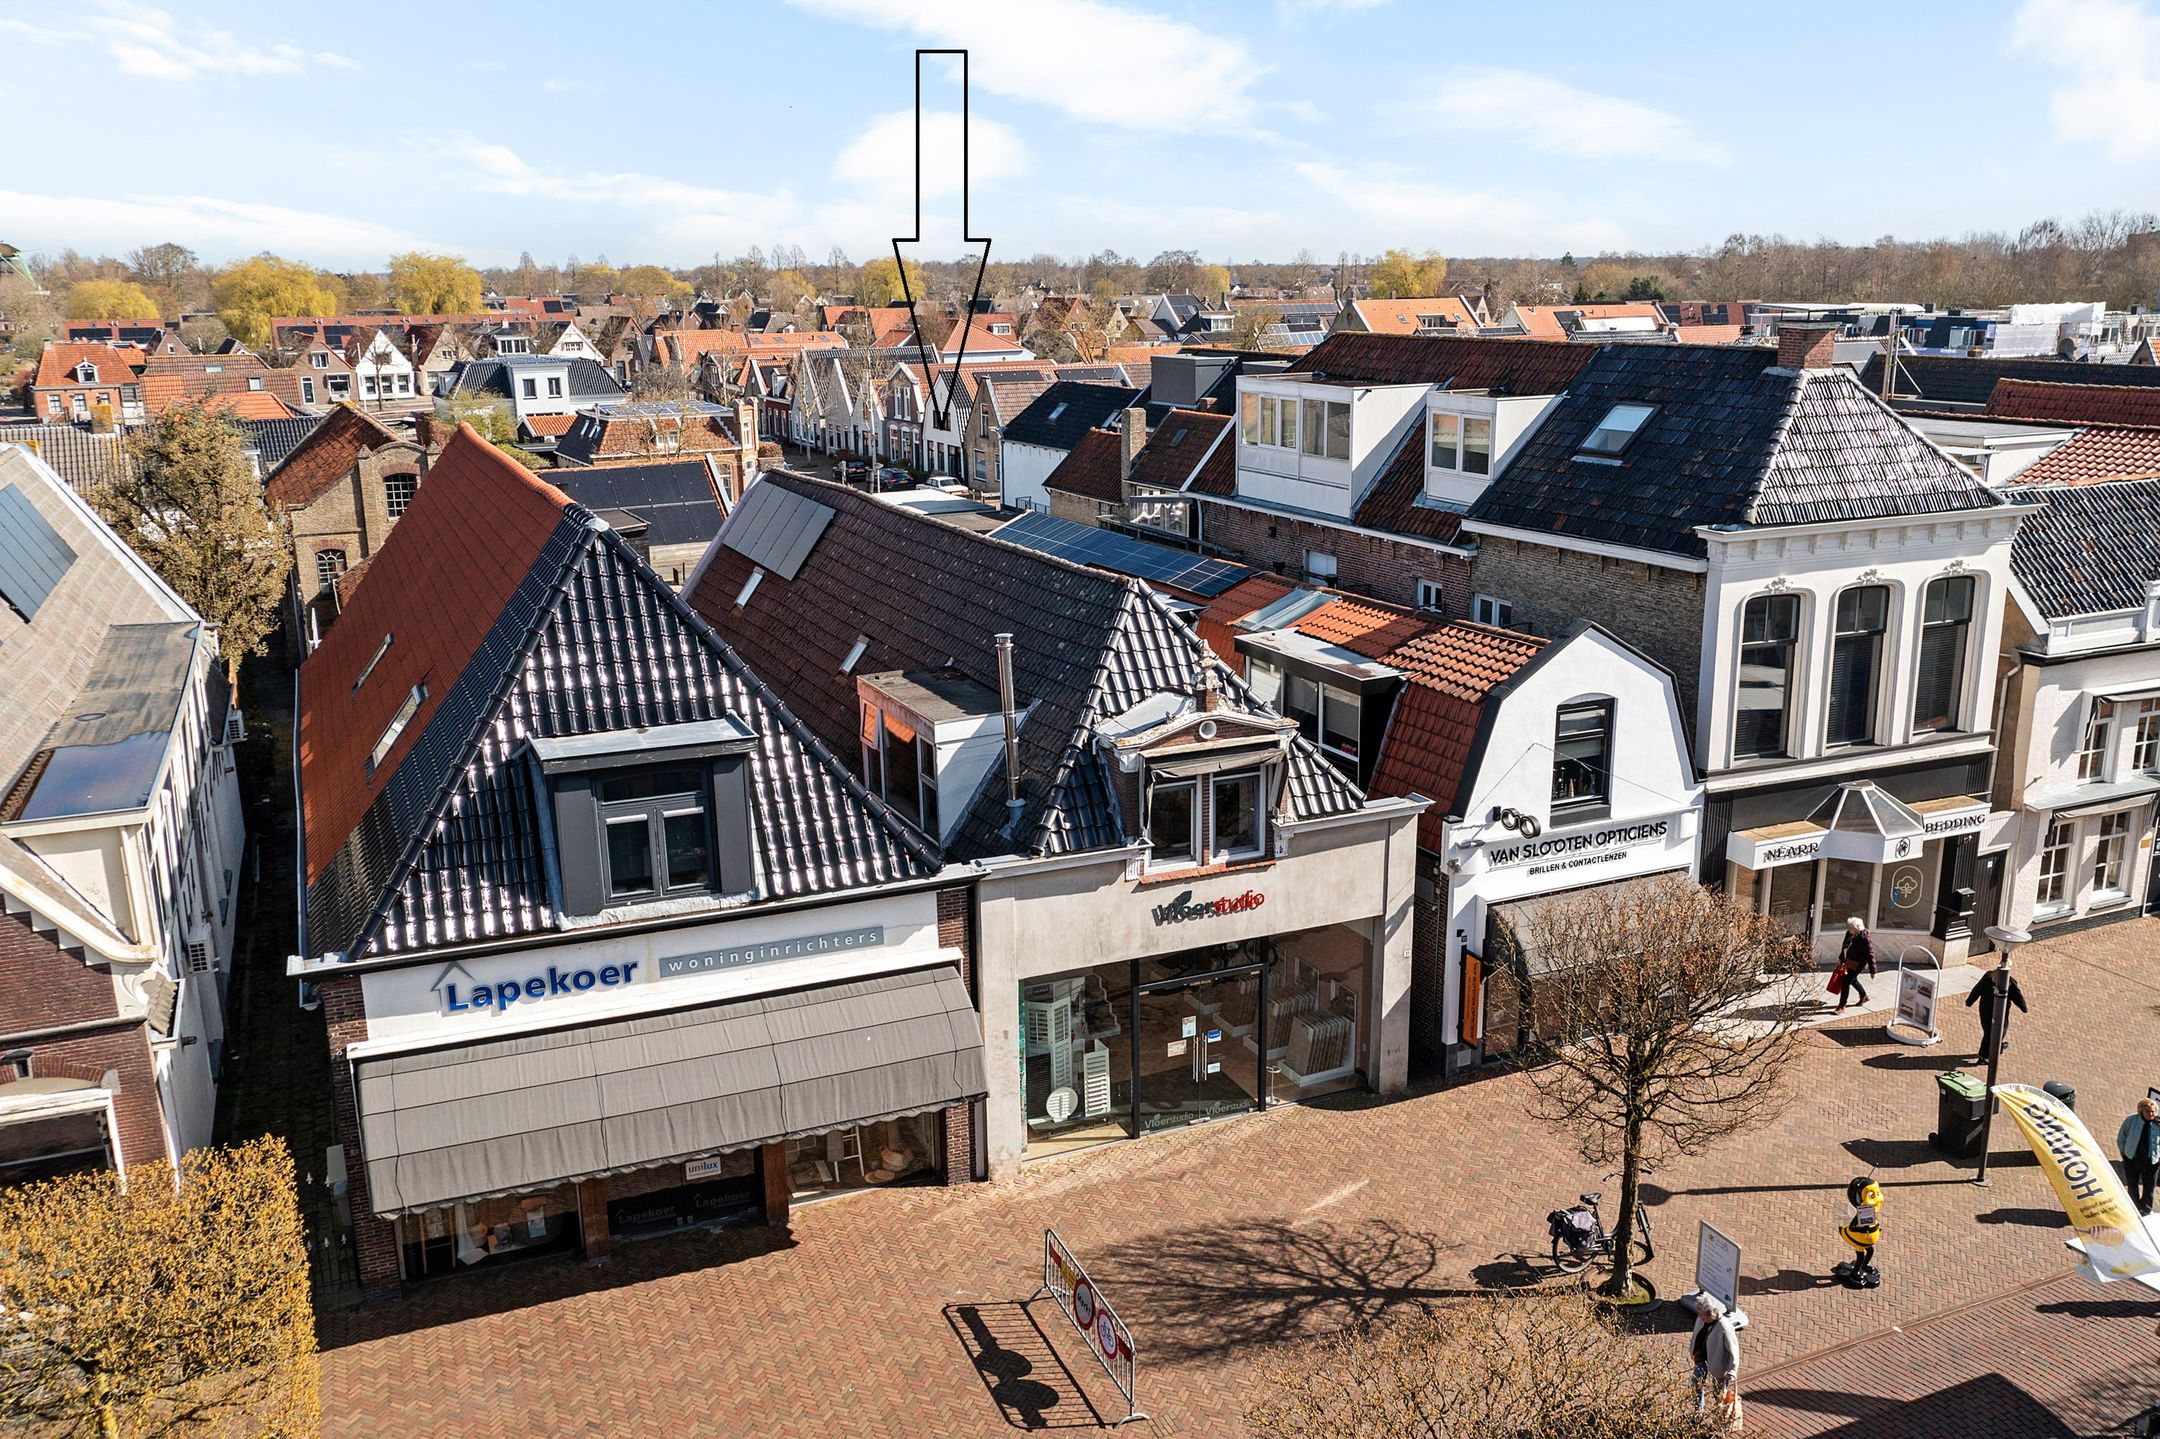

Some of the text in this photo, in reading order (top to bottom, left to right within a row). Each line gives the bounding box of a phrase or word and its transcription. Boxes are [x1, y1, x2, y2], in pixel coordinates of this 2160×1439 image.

[1924, 814, 1986, 833] BEDDING
[1490, 821, 1668, 864] VAN SLOOTEN OPTICIENS
[1529, 851, 1628, 876] BRILLEN & CONTACTLENZEN
[668, 930, 878, 972] woninginrichters
[447, 960, 639, 1012] Lapekoer
[1206, 1100, 1254, 1116] Vloerstudio
[1145, 1112, 1194, 1129] Vloerstudio
[688, 1161, 718, 1173] unilux
[696, 1192, 750, 1209] Lapekoer
[619, 1205, 676, 1224] Lapekoer
